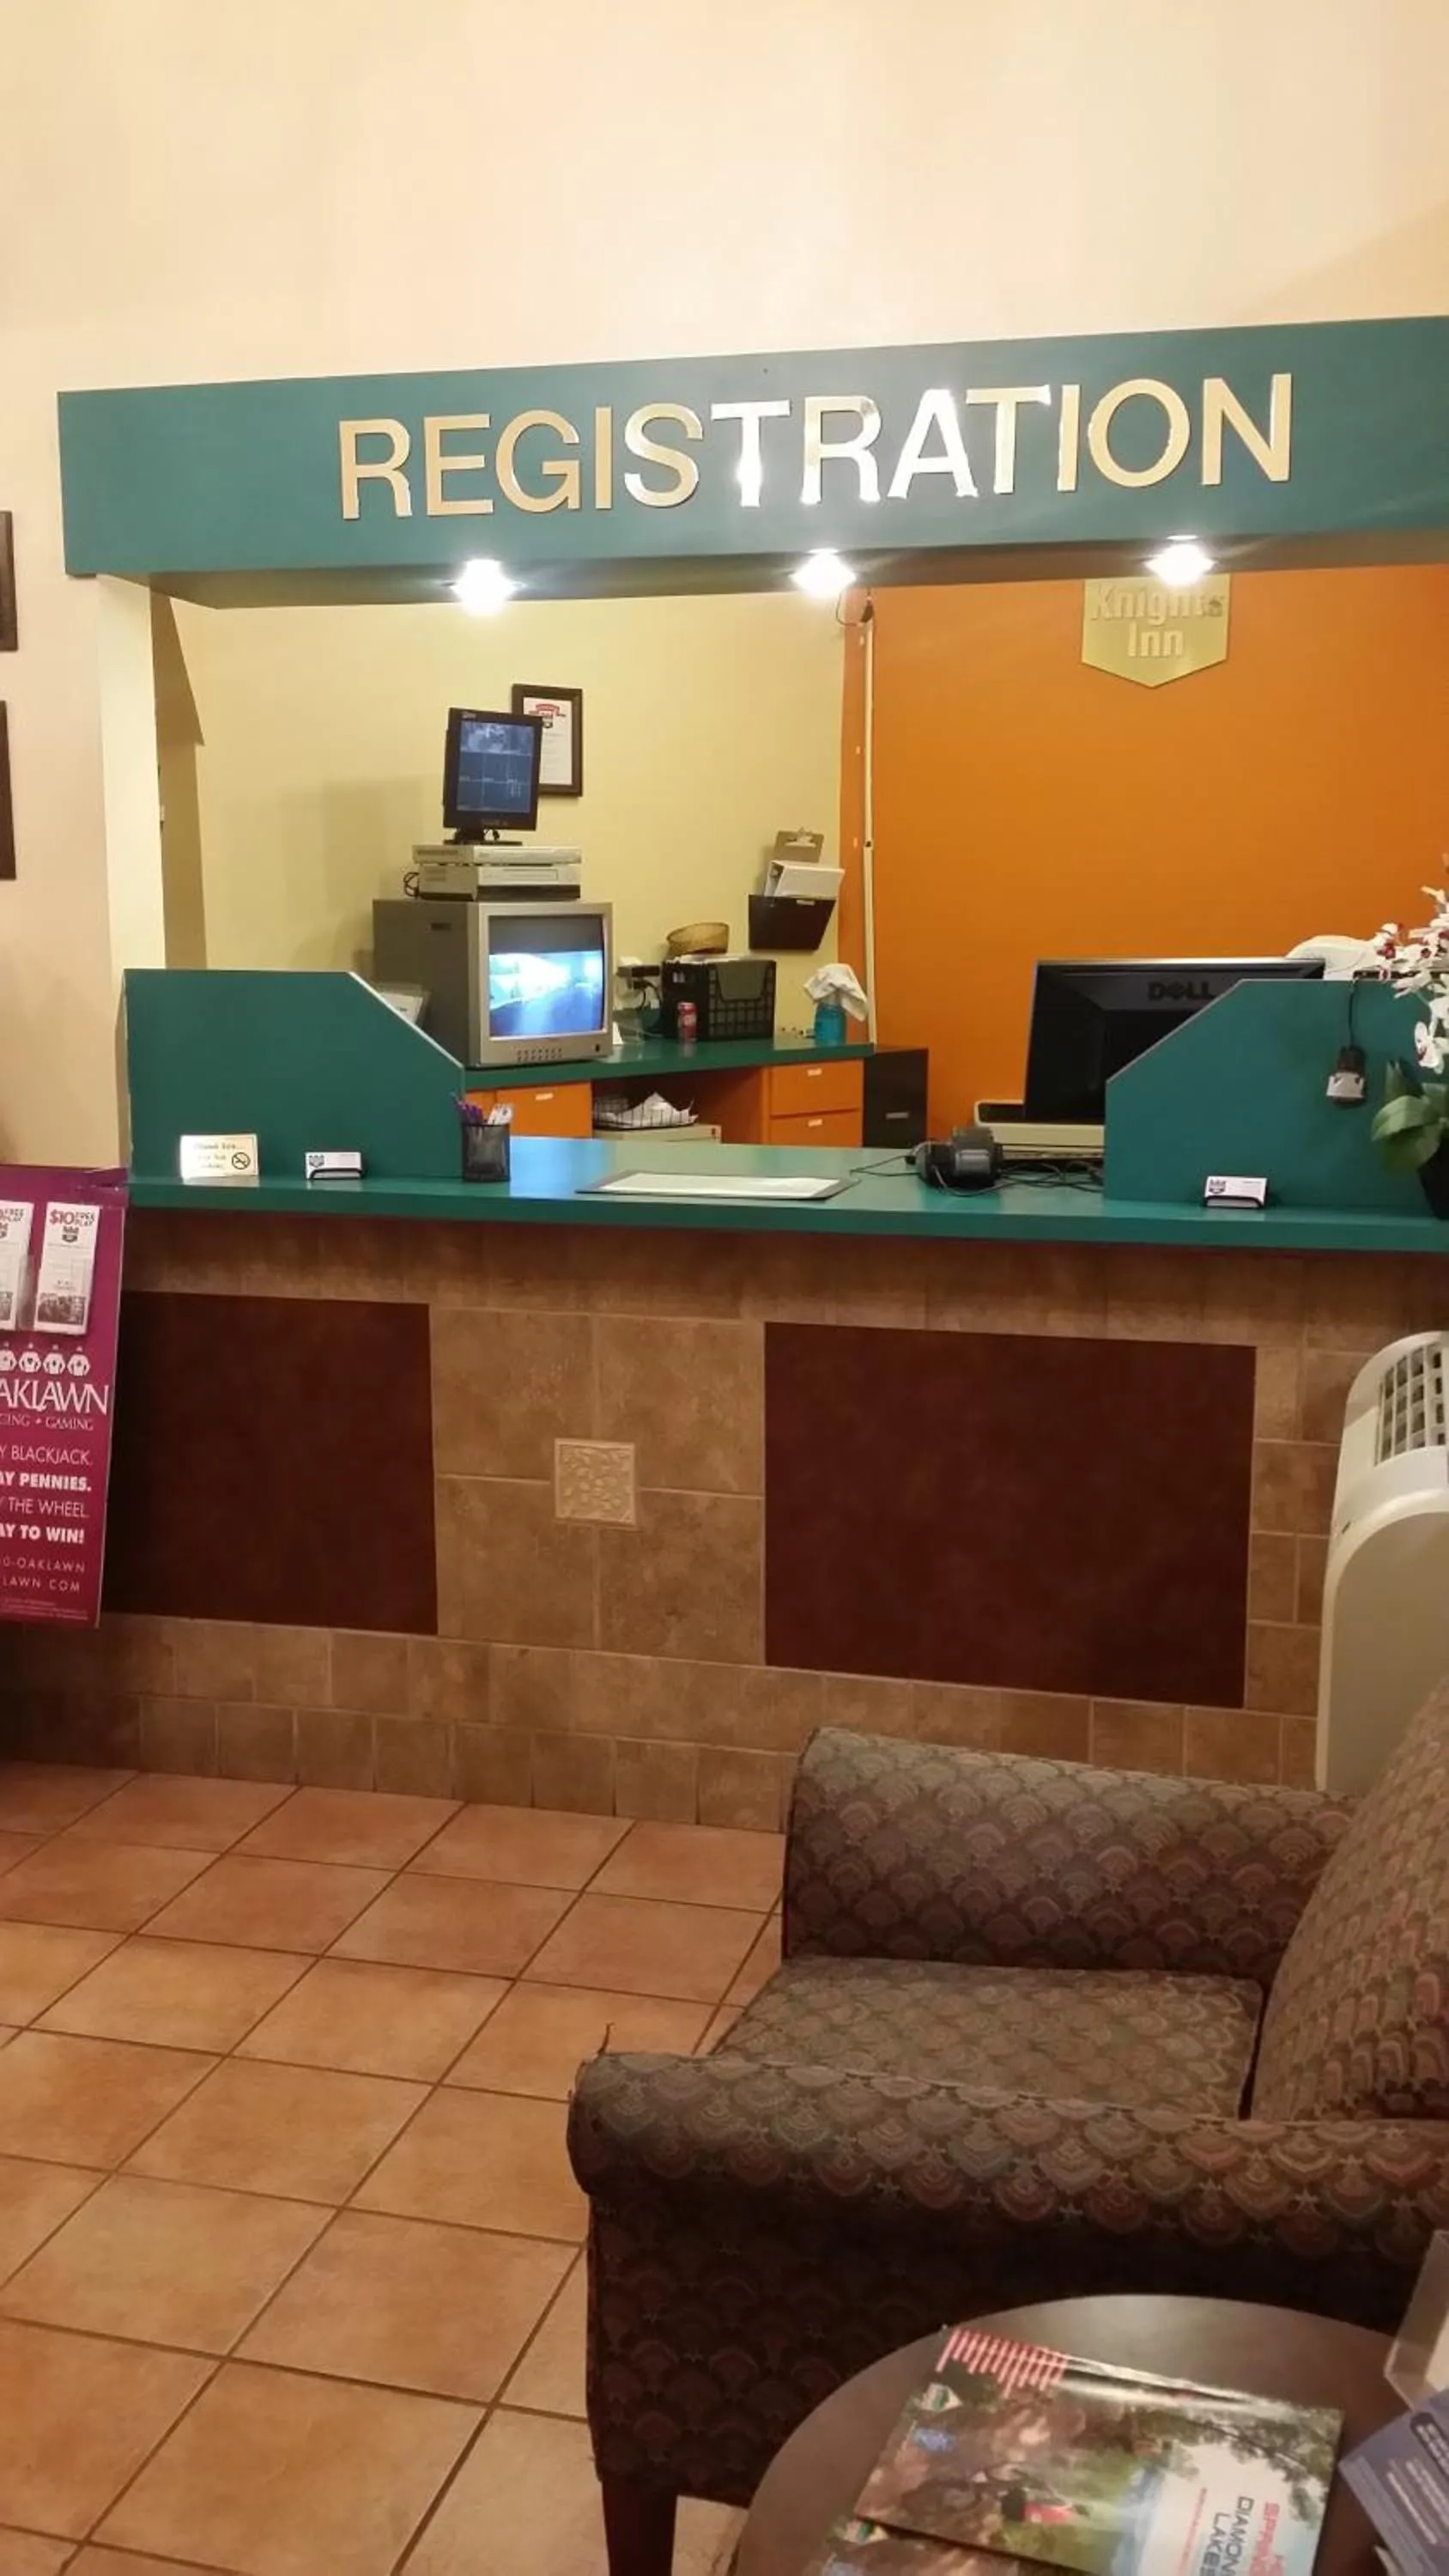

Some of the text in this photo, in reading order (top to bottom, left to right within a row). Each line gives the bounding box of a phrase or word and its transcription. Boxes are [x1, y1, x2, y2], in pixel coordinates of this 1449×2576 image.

[339, 373, 1293, 519] REGISTRATION
[1127, 618, 1185, 659] Inn
[1148, 981, 1216, 1001] DELL
[49, 1209, 75, 1225] $10
[45, 1416, 94, 1431] GAMING
[20, 1473, 92, 1492] PENNIES.
[8, 1497, 33, 1514] THE
[20, 1524, 41, 1540] TO
[45, 1526, 85, 1544] WIN!
